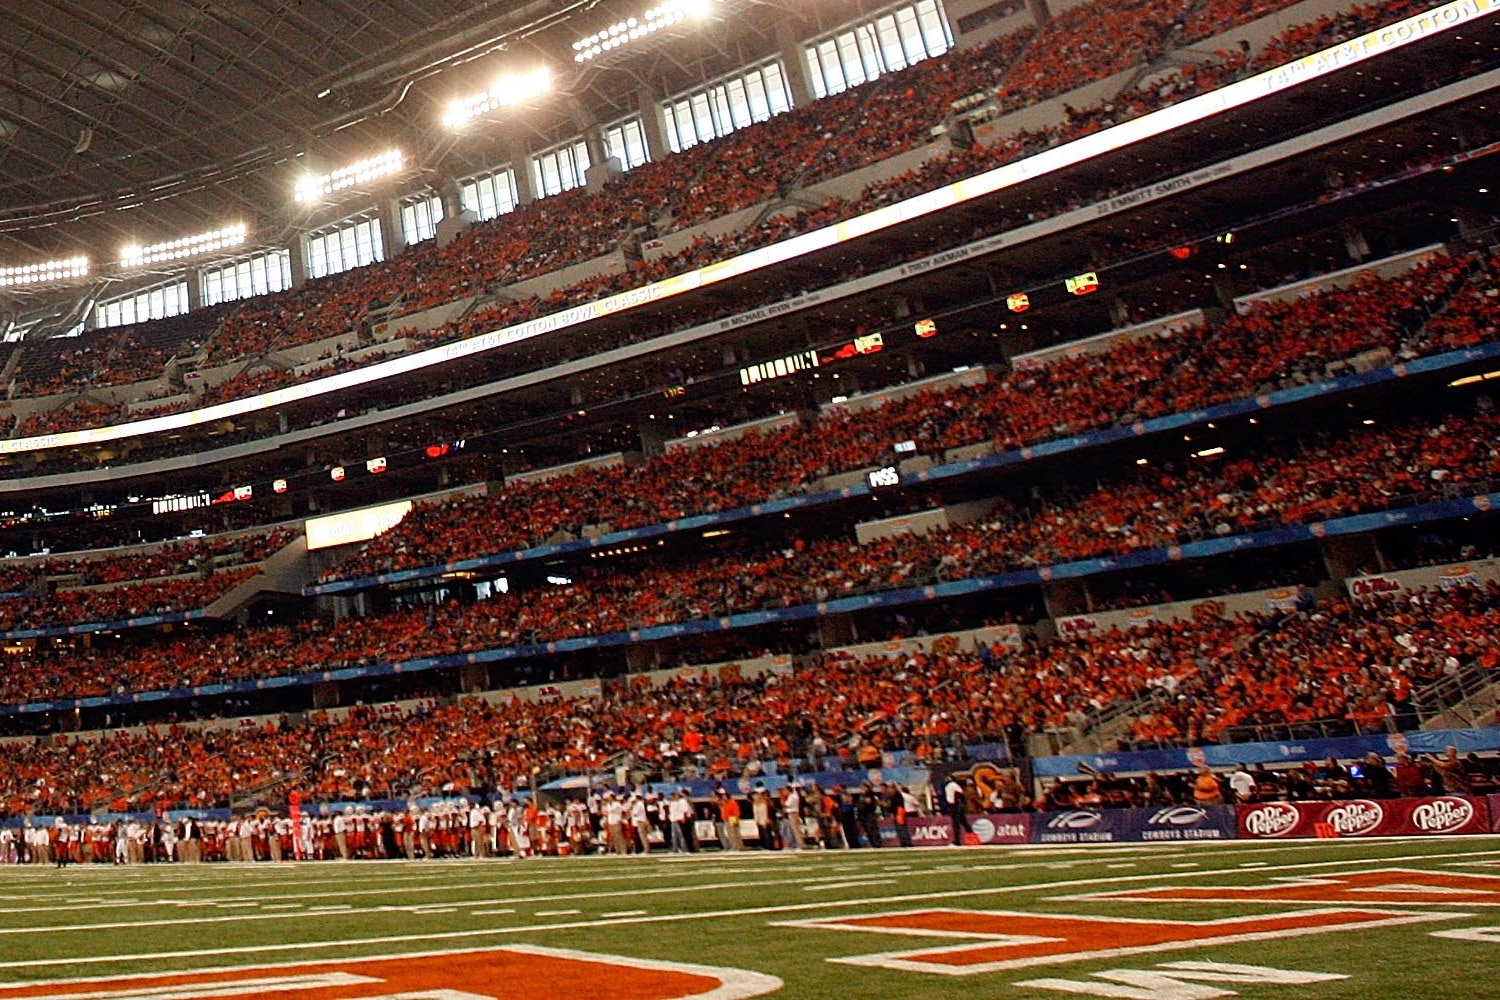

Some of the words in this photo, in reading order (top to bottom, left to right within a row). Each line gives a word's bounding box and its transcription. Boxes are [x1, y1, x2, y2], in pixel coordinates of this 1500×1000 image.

[1111, 189, 1152, 210] EMMITT
[1156, 177, 1192, 195] SMITH
[908, 258, 932, 273] TROY
[933, 249, 969, 267] AIKMAN
[505, 317, 557, 343] COTTON
[560, 306, 600, 326] BOWL
[602, 286, 662, 312] CLASSIC
[731, 310, 766, 326] MICHAEL
[768, 303, 791, 315] IRVIN
[9, 437, 58, 452] CLASSIC
[1262, 806, 1283, 819] Dr
[1348, 803, 1366, 816] Dr
[1434, 799, 1454, 813] Dr
[1248, 811, 1295, 835] Pepper
[1332, 807, 1379, 834] Pepper
[1419, 804, 1468, 831] Pepper
[911, 825, 949, 840] JACK
[996, 823, 1026, 837] at&t
[1041, 832, 1077, 842] COWBOYS
[1079, 832, 1113, 842] STADIUM
[1142, 830, 1182, 840] COWBOYS
[1184, 829, 1220, 839] STADIUM
